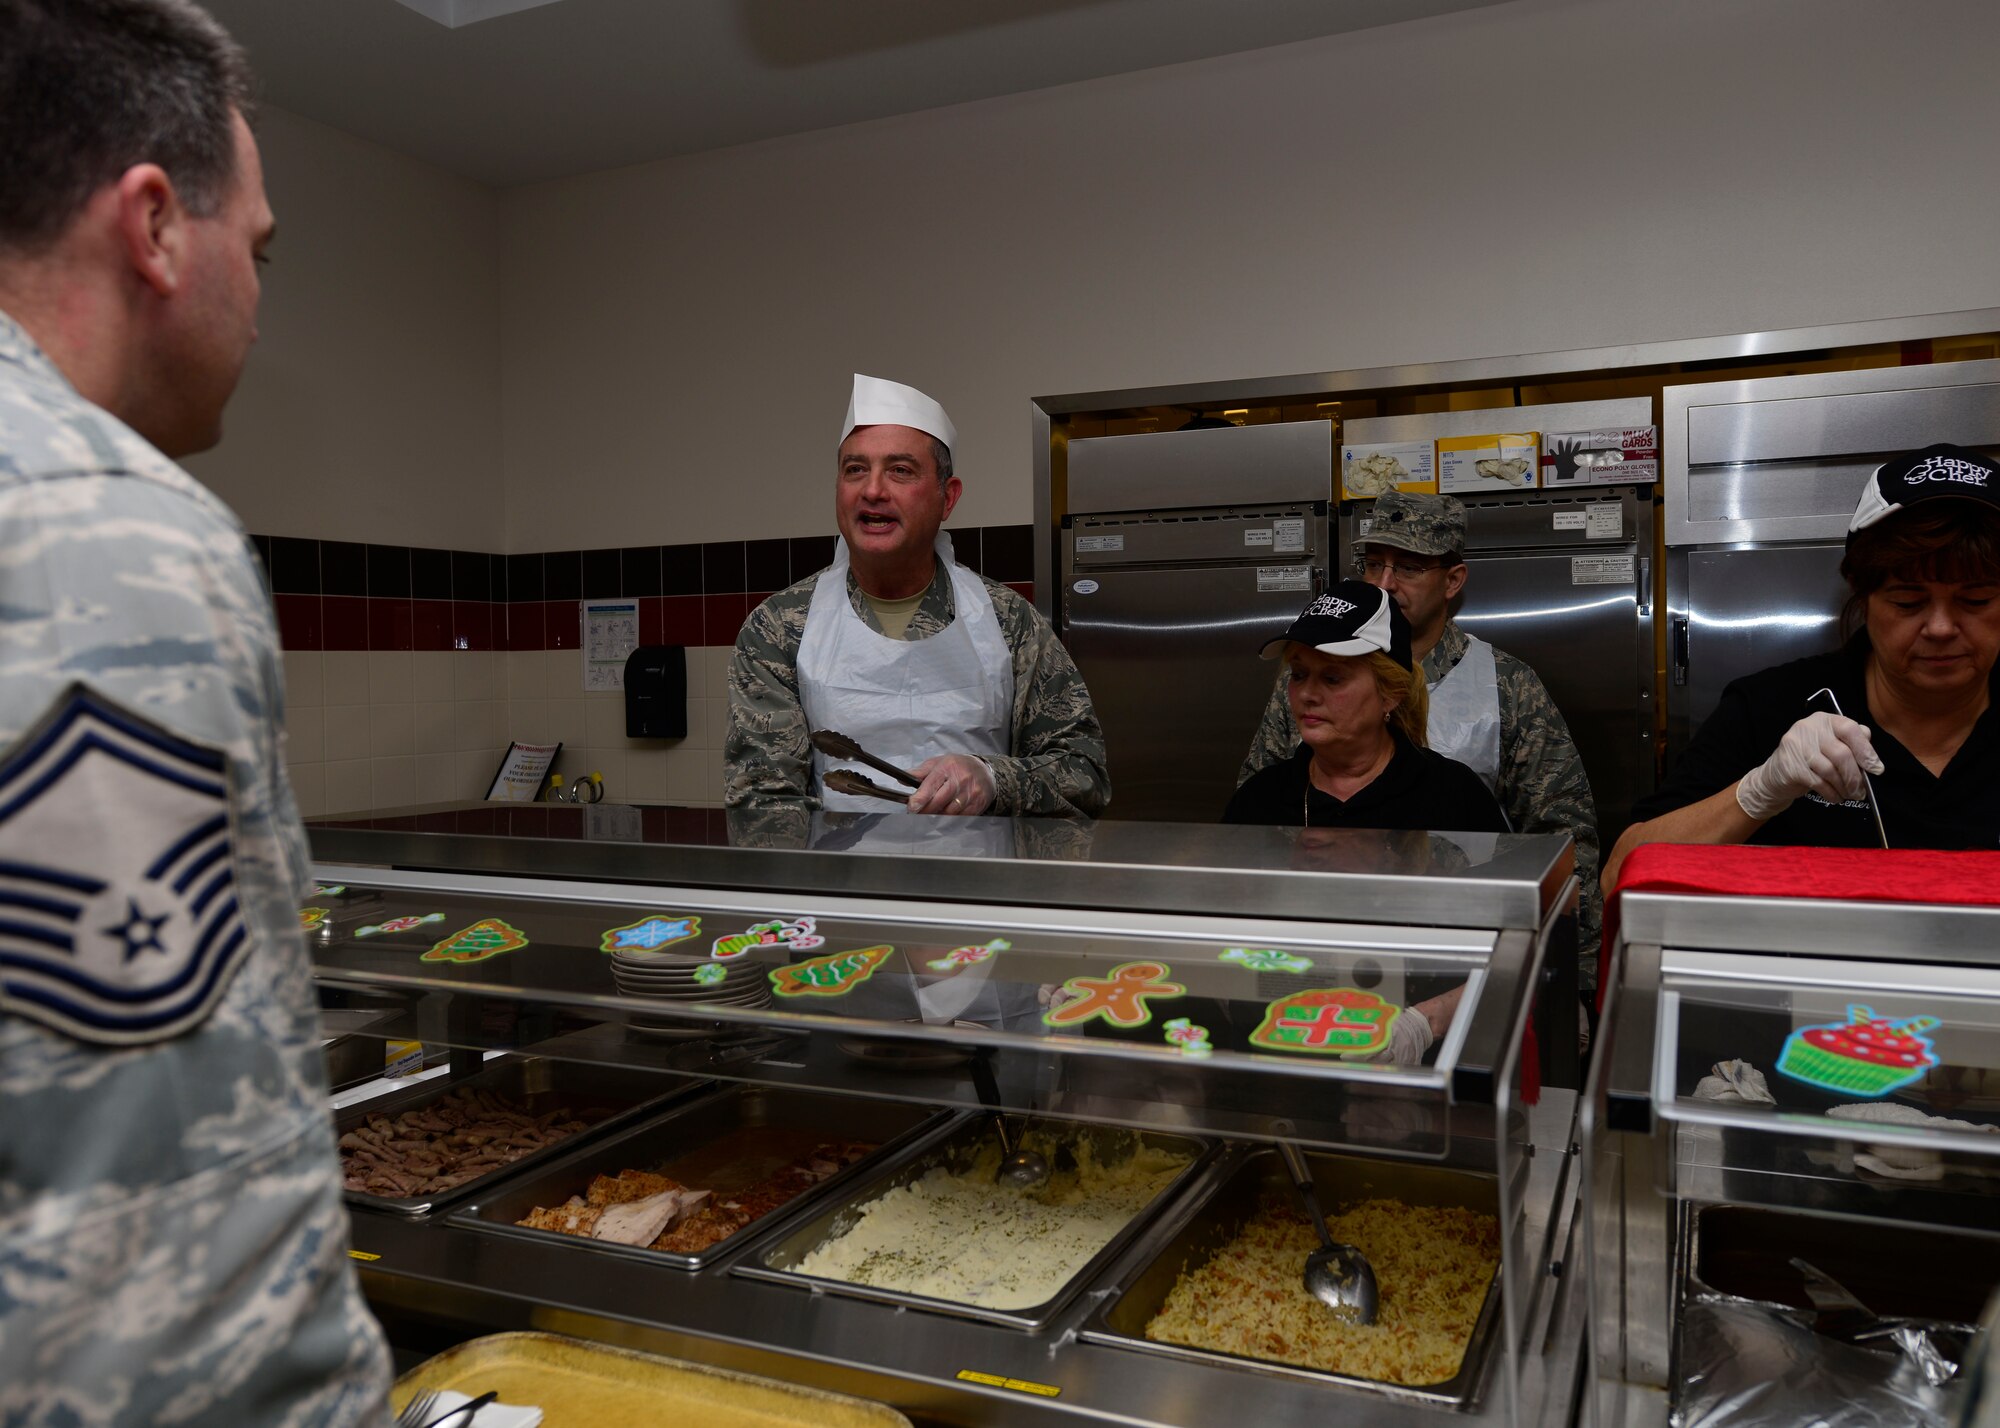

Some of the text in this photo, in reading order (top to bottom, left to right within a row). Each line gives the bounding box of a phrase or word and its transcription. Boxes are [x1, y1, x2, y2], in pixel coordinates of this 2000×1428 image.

[1622, 429, 1645, 438] VALU
[1622, 437, 1654, 448] GARDS
[1924, 455, 1993, 480] Happy
[1928, 466, 1983, 486] Chef
[1310, 603, 1344, 618] Chef
[1316, 593, 1358, 614] Happy
